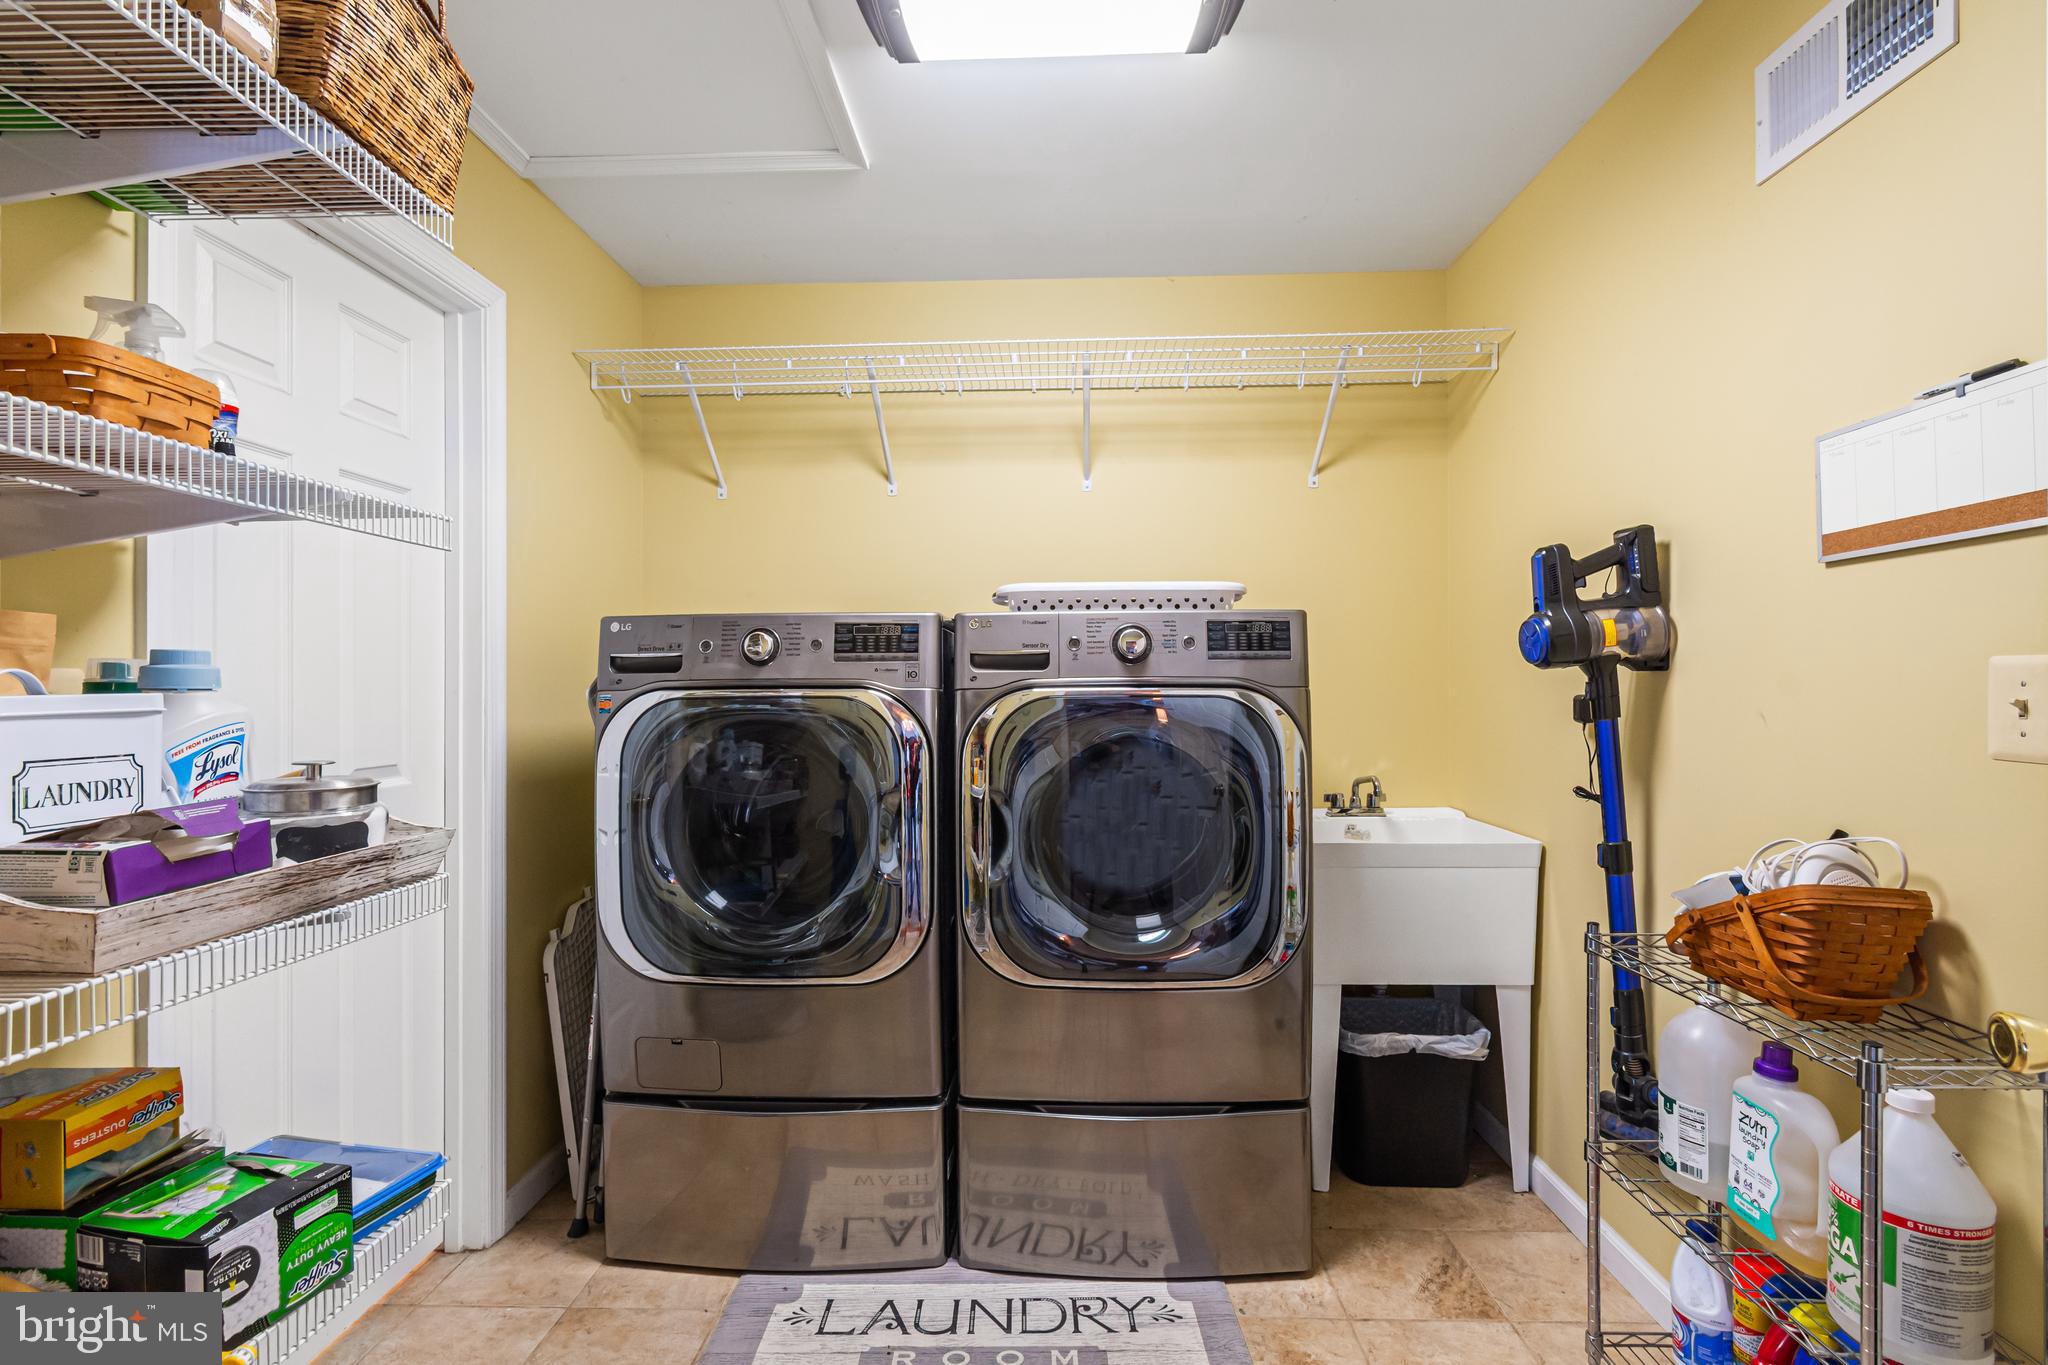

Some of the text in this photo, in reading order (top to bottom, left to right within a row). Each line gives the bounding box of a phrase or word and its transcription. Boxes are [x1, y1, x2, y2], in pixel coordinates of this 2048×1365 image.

[620, 623, 632, 631] LG
[981, 620, 993, 629] LG
[171, 749, 184, 759] FREE
[185, 740, 202, 751] FROM
[202, 730, 231, 744] FRAGRANCE
[194, 745, 239, 781] Lysol
[22, 776, 136, 810] LAUNDRY
[76, 1071, 158, 1108] Swiffer
[128, 1092, 181, 1127] Swiffer
[73, 1118, 126, 1148] DUSTERS
[1829, 1181, 1858, 1207] TRATE
[317, 1226, 348, 1254] HEAVY
[1907, 1220, 1993, 1238] 6 TIMES STRONGER
[1828, 1224, 1859, 1265] GA
[236, 1257, 252, 1272] 2X
[286, 1251, 314, 1272] DUTY
[289, 1250, 348, 1297] Swiffer
[213, 1267, 239, 1287] ULTRA
[814, 1296, 1156, 1336] LAUNDRY
[891, 1349, 1079, 1365] ROOM
